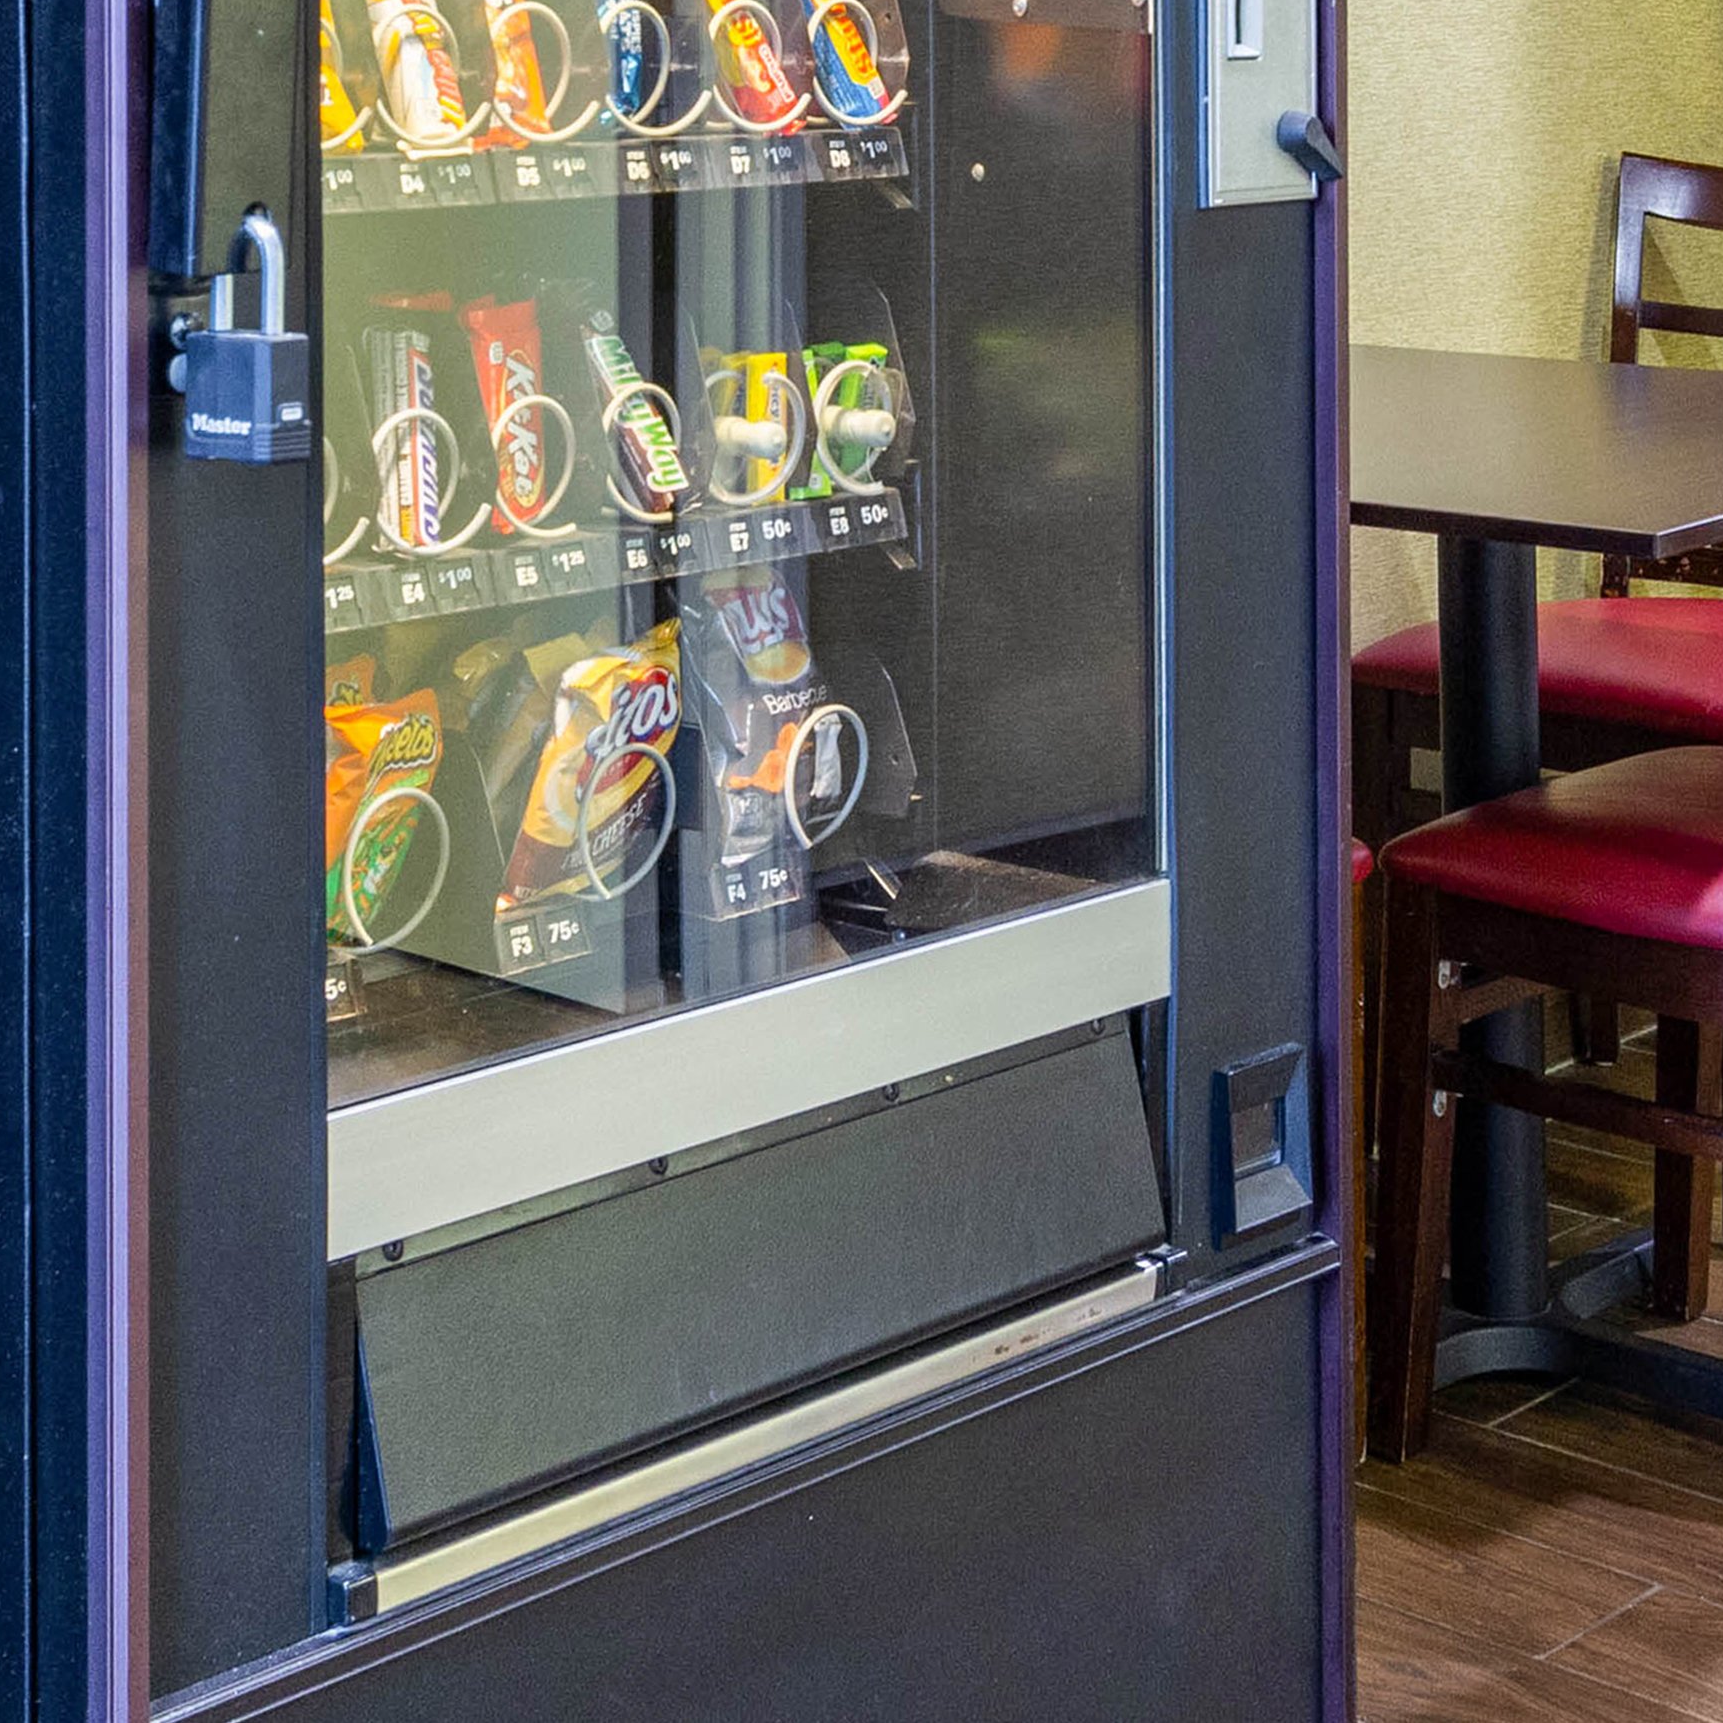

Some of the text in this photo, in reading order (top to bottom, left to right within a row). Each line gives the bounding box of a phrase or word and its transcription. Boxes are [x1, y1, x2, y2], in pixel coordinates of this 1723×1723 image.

[730, 155, 751, 175] D7
[829, 148, 851, 169] D8
[191, 412, 253, 436] Master
[829, 504, 889, 536] E8 50¢
[730, 520, 792, 553] E7 50¢
[401, 584, 426, 605] E4
[591, 792, 648, 856] CHEESE
[727, 882, 747, 903] F4
[759, 868, 789, 890] 75¢
[511, 934, 534, 958] F3
[547, 920, 580, 944] 75¢
[325, 978, 348, 1000] 5¢
